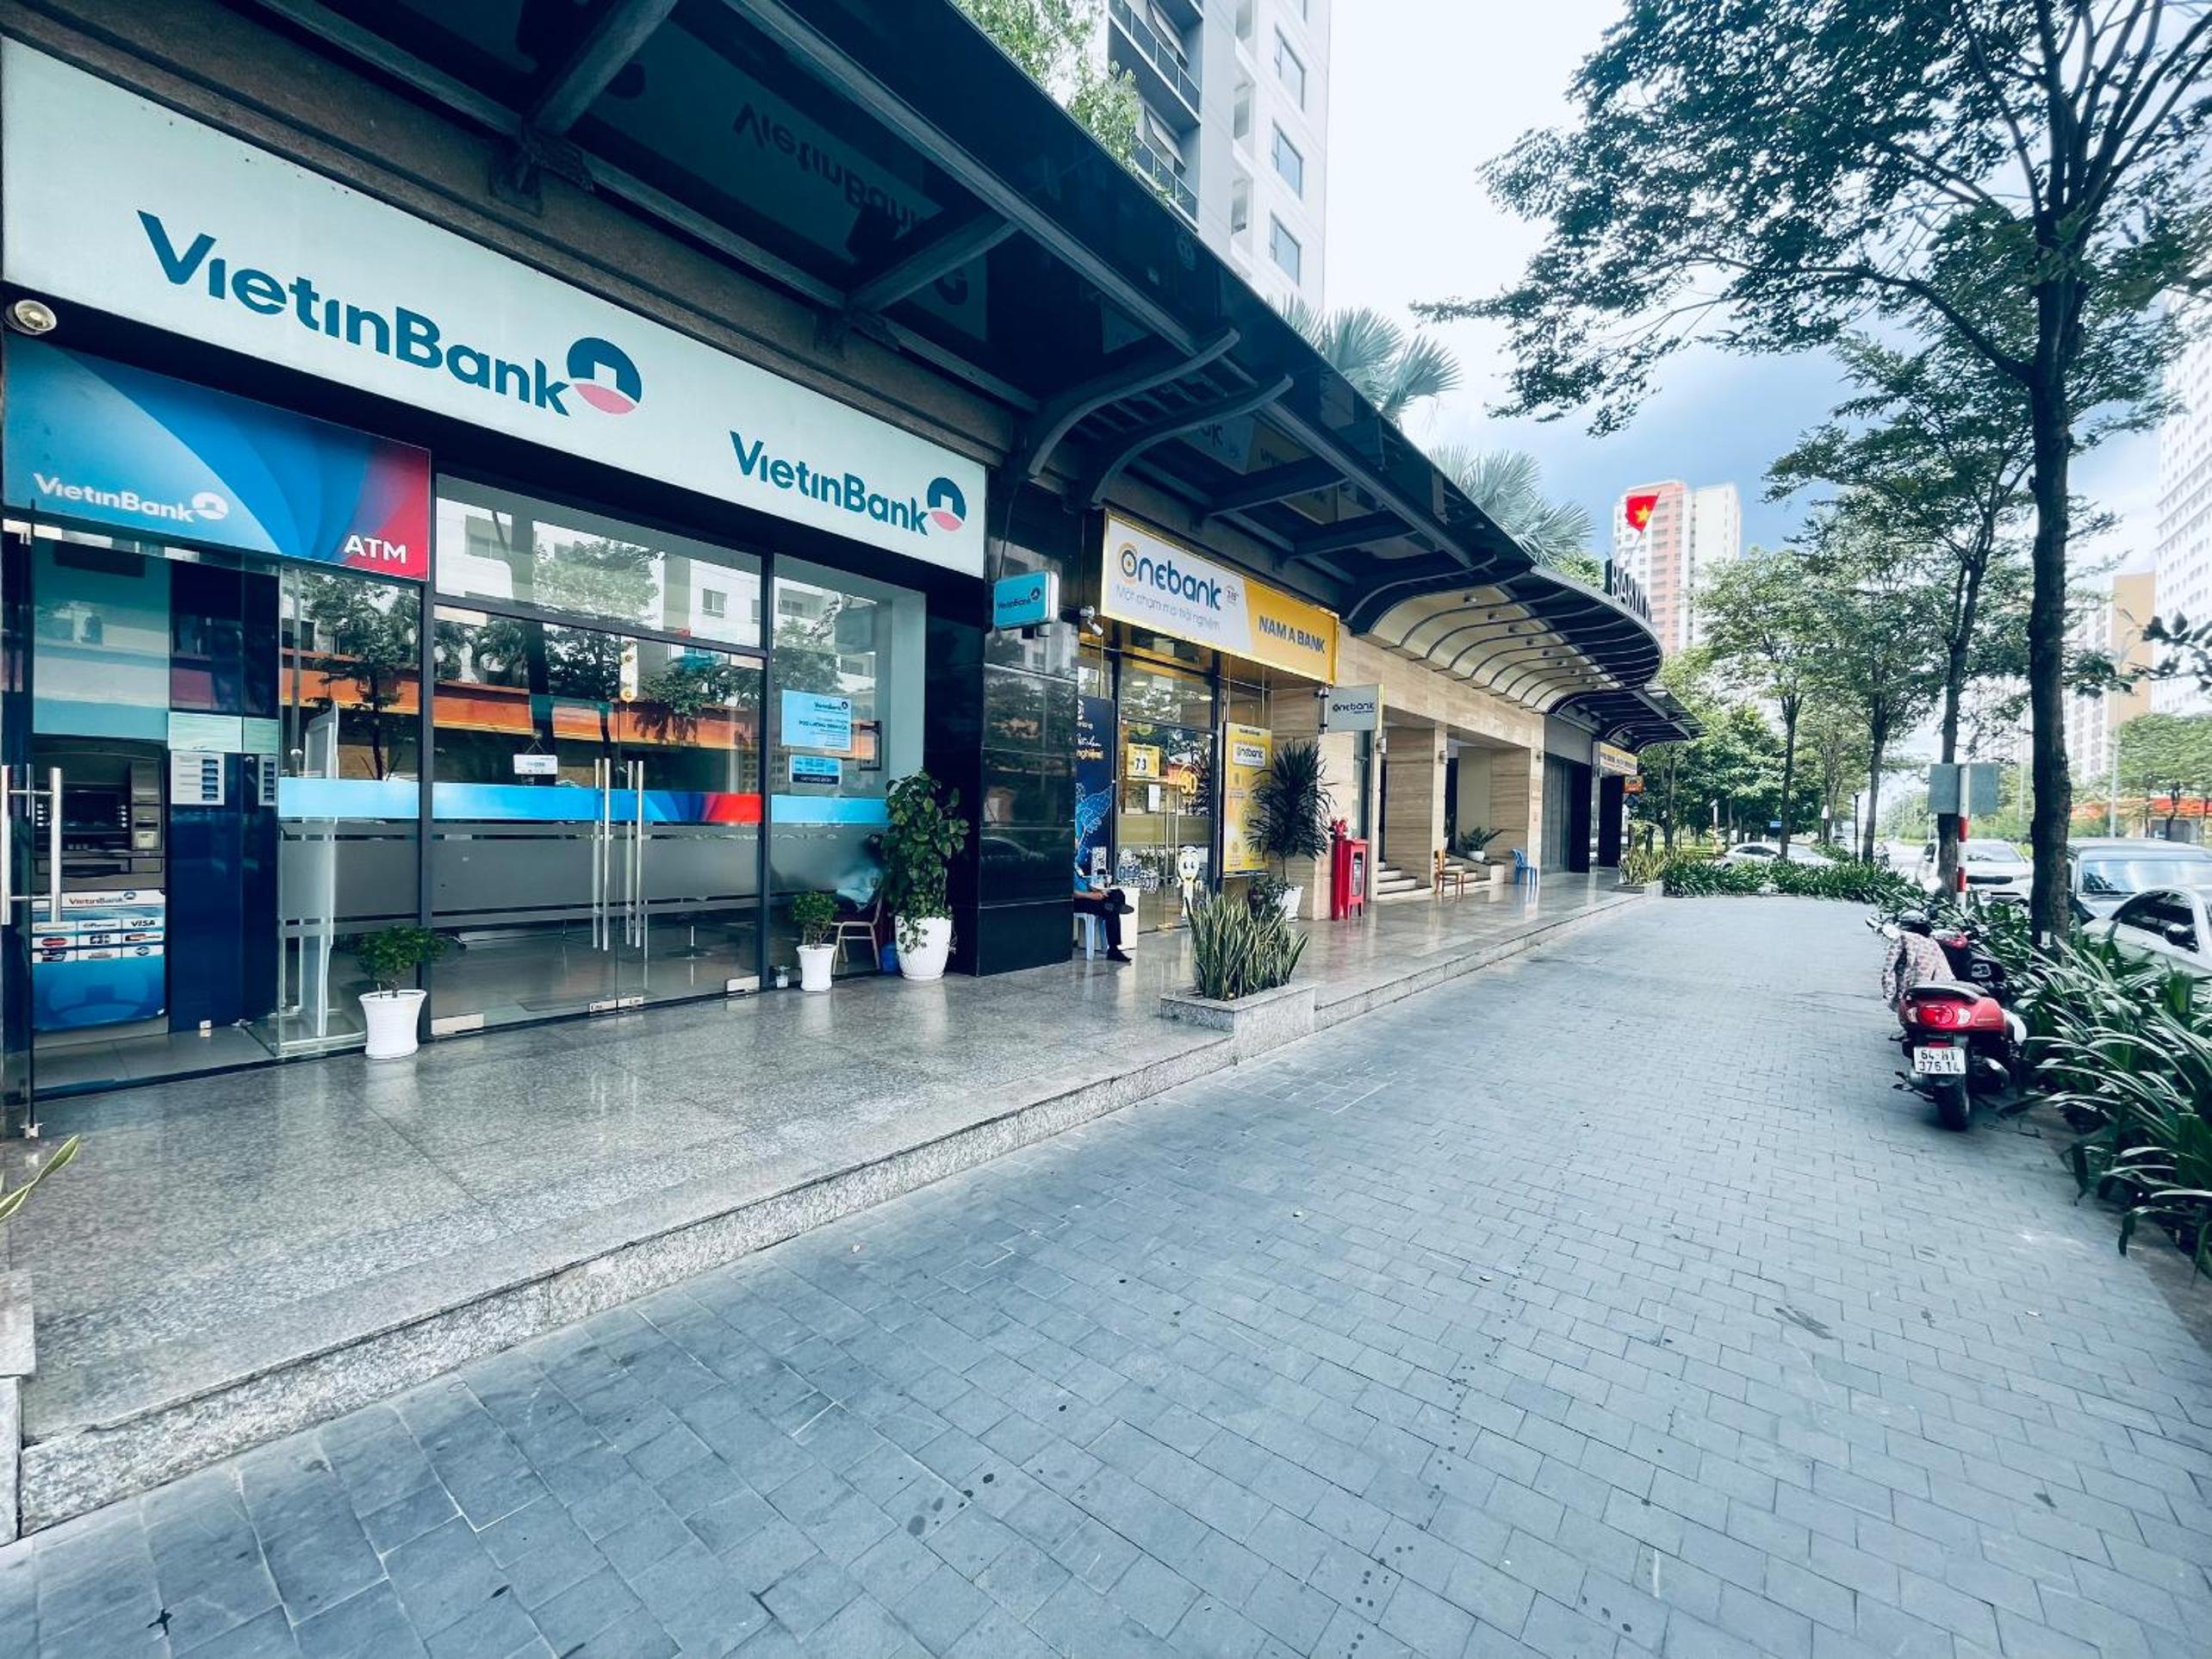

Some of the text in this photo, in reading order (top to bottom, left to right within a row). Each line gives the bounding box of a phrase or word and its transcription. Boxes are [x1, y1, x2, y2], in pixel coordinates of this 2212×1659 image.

[136, 208, 574, 416] VietinBank
[33, 472, 196, 523] VietinBank
[730, 430, 929, 536] VietinBank
[344, 534, 407, 564] ATM
[1259, 615, 1326, 654] NAM A BANK
[131, 919, 156, 928] VISA
